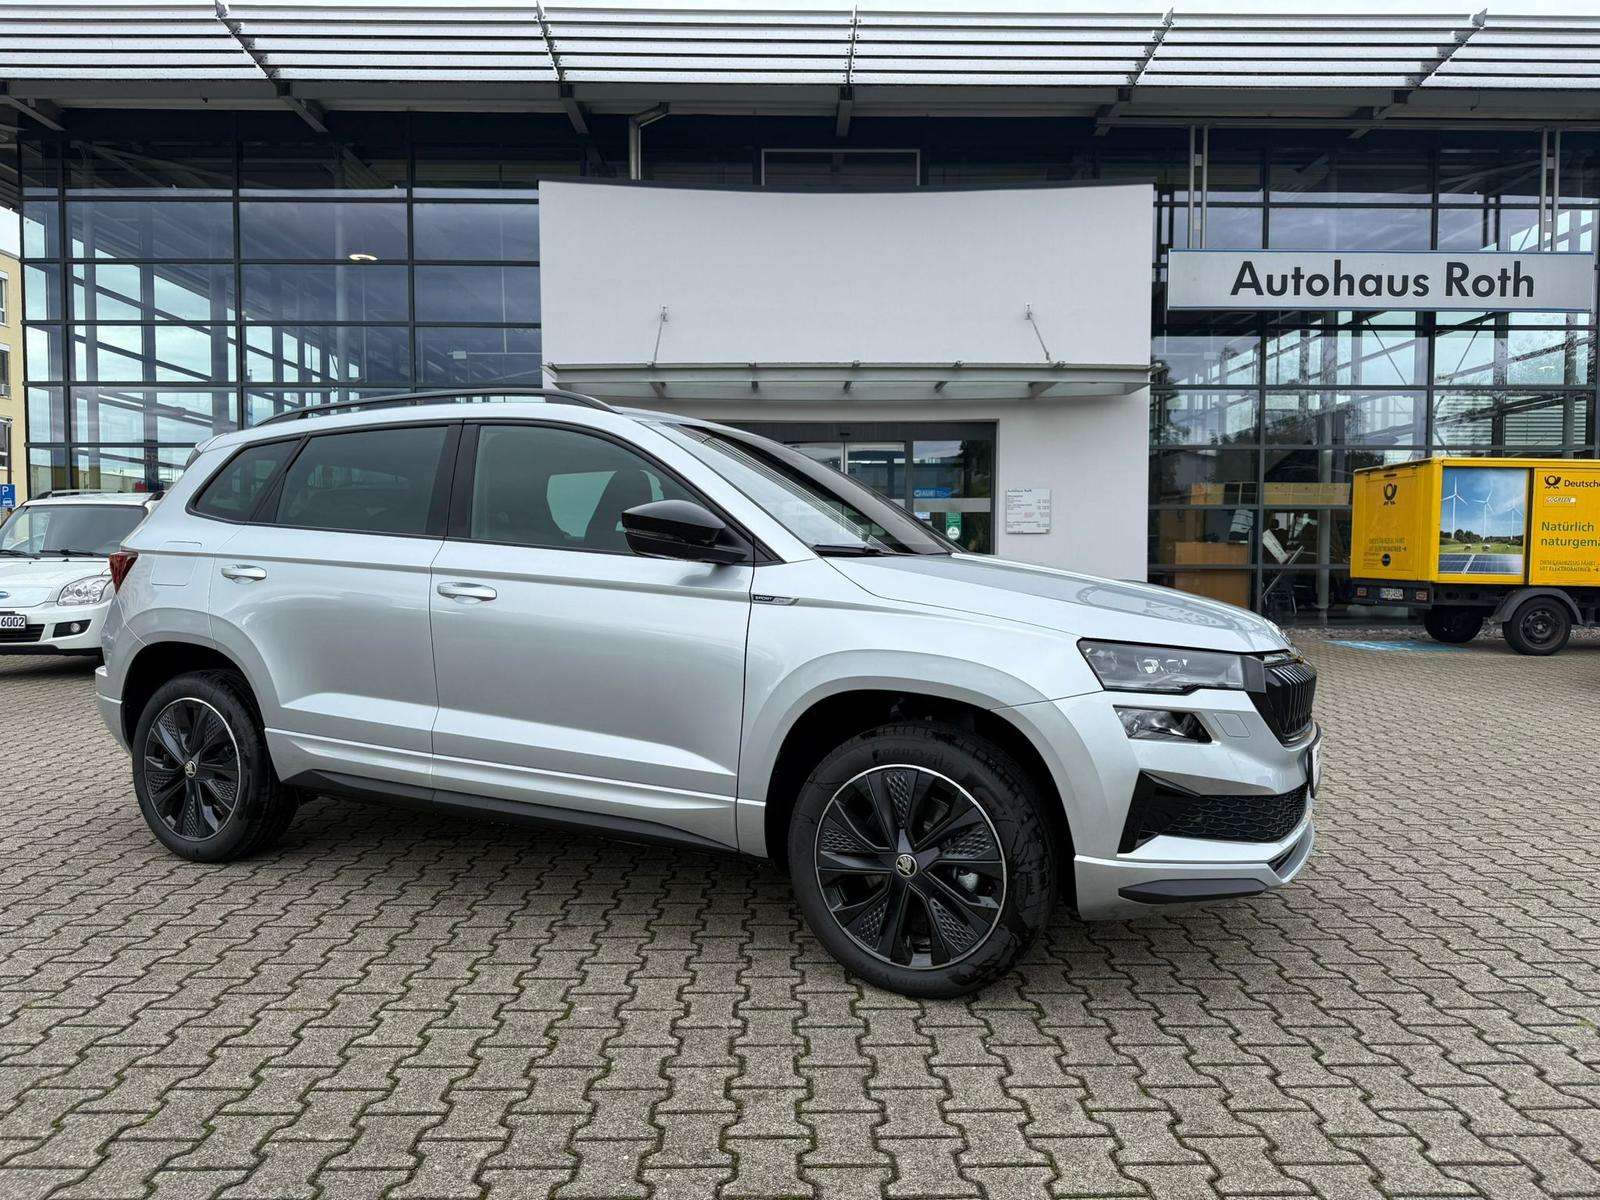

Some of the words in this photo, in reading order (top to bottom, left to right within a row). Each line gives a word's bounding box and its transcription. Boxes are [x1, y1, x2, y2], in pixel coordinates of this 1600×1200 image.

[1230, 259, 1430, 297] Autohaus
[1445, 260, 1535, 297] Roth
[1564, 480, 1600, 488] Deutsch
[2, 486, 9, 495] P
[1541, 521, 1595, 532] Natürlich
[1, 616, 25, 628] 6002
